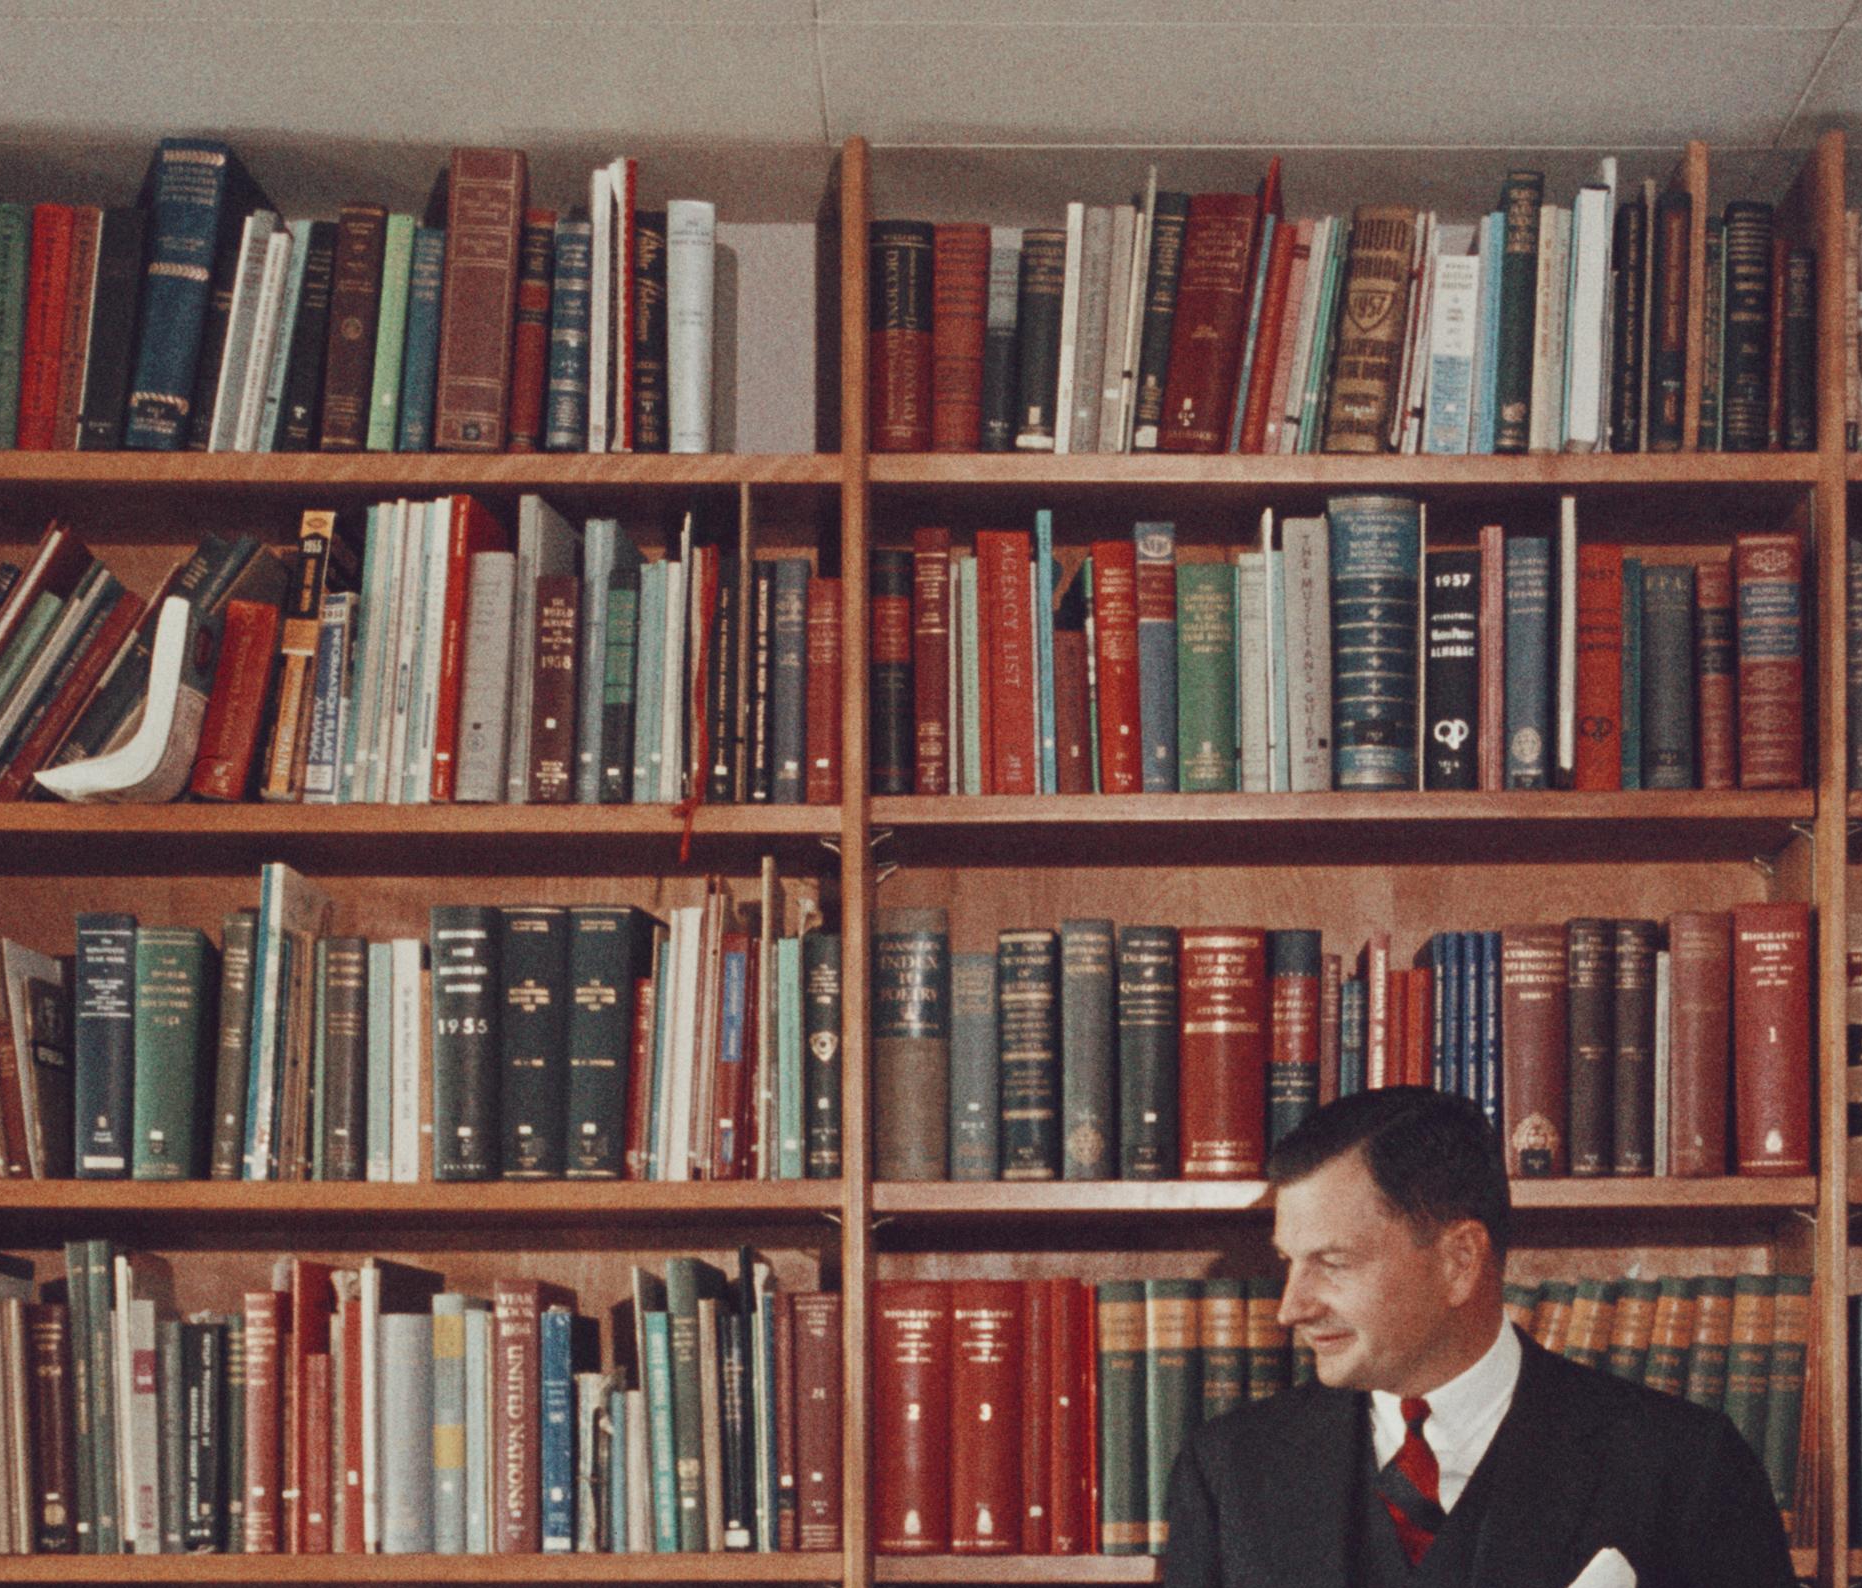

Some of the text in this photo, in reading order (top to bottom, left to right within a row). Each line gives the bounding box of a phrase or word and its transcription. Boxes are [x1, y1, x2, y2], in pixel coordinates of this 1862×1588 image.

[1434, 573, 1472, 588] 1957
[999, 540, 1022, 690] AGENCY LIST
[880, 955, 938, 970] INDEX
[437, 1016, 489, 1035] 1955
[1768, 1025, 1777, 1043] 1
[907, 1403, 921, 1421] 2
[978, 1403, 992, 1421] 3
[506, 1344, 528, 1510] UNITED NATIONS
